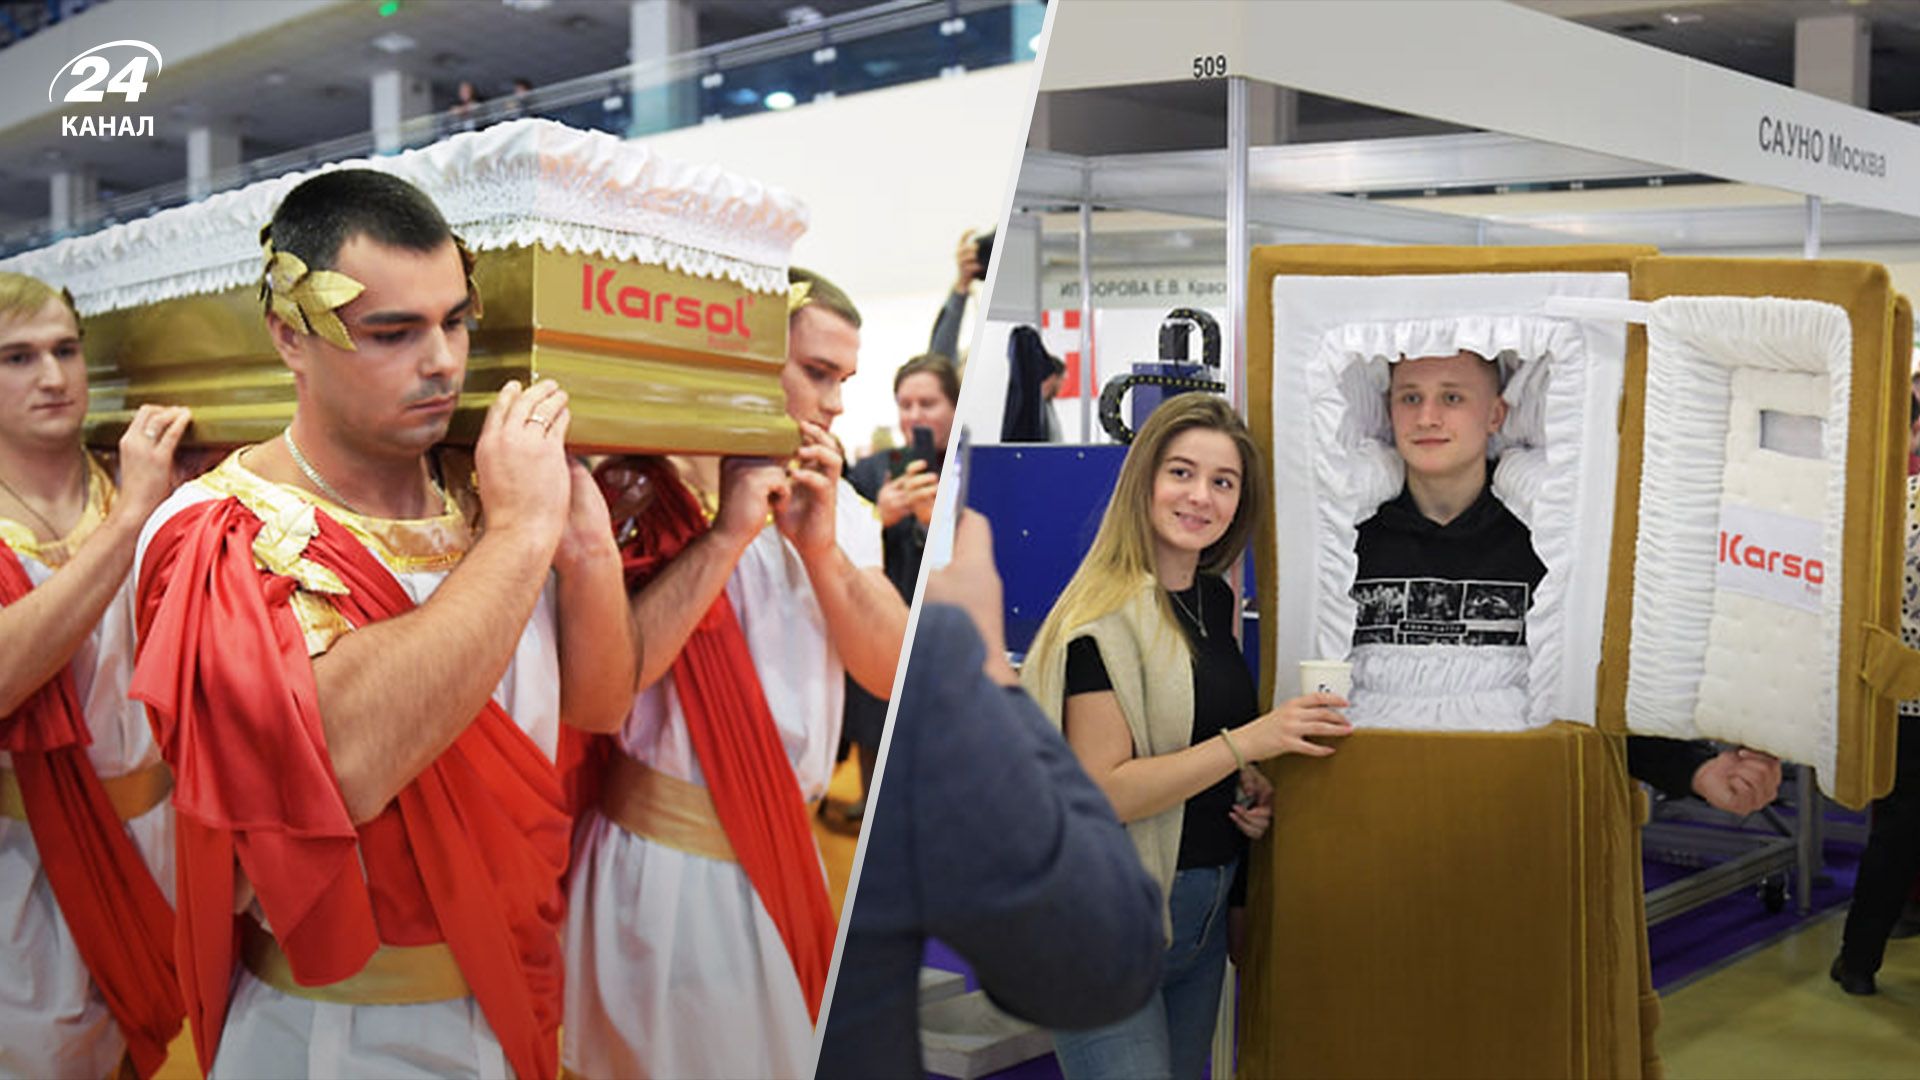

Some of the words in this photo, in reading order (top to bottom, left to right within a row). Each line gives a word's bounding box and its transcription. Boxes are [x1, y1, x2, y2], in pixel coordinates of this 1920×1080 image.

[1193, 54, 1227, 79] 509
[1758, 115, 1825, 164] САУНО
[1828, 133, 1887, 178] Москва
[581, 262, 752, 339] Karsol
